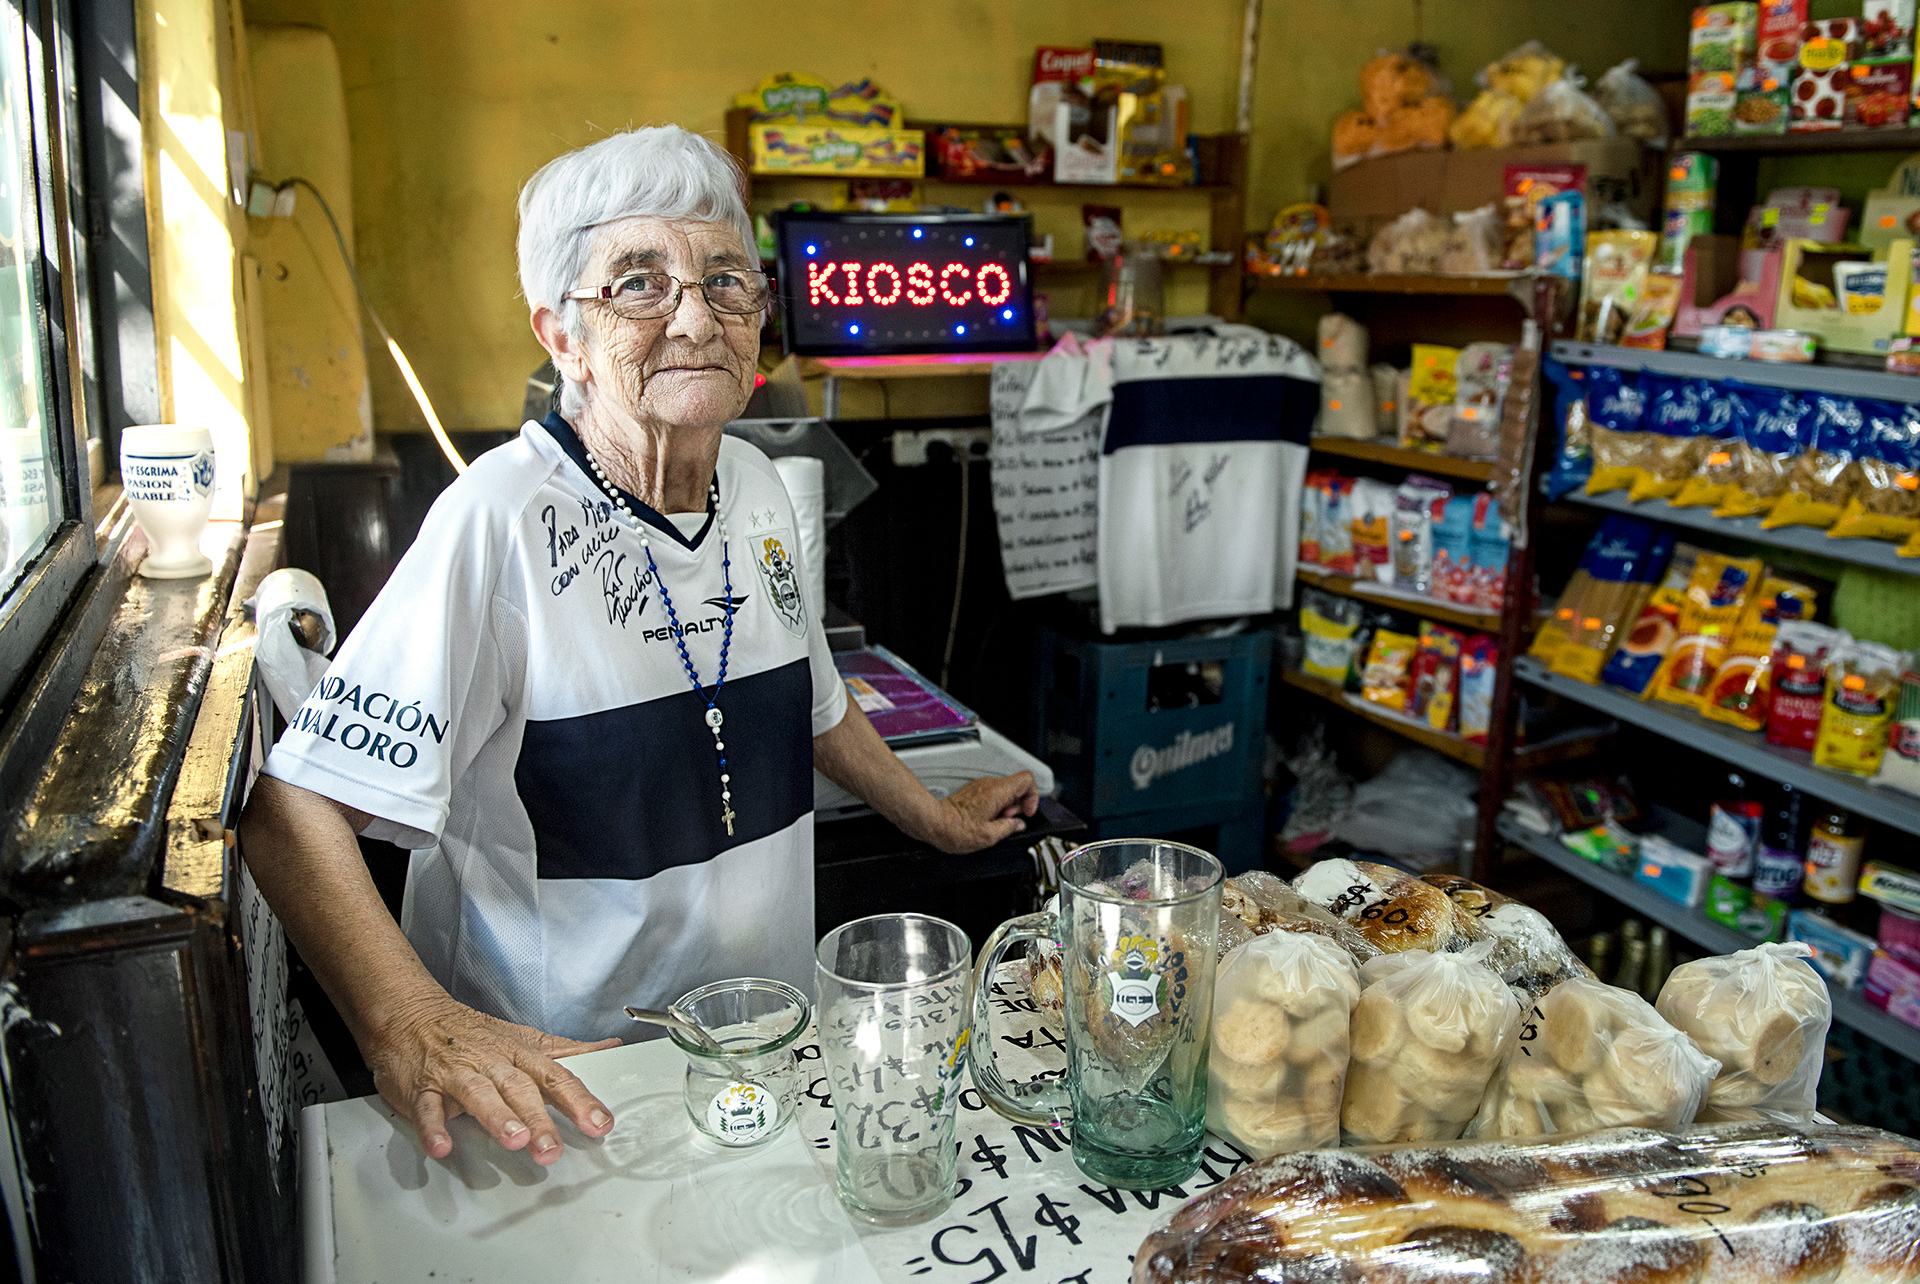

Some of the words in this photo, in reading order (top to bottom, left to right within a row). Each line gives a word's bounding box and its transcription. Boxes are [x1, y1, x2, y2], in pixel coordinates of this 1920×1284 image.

[808, 262, 1011, 306] KIOSCO
[136, 466, 178, 476] ESGRIMA
[127, 479, 172, 489] PASION
[642, 614, 728, 644] PENALTY
